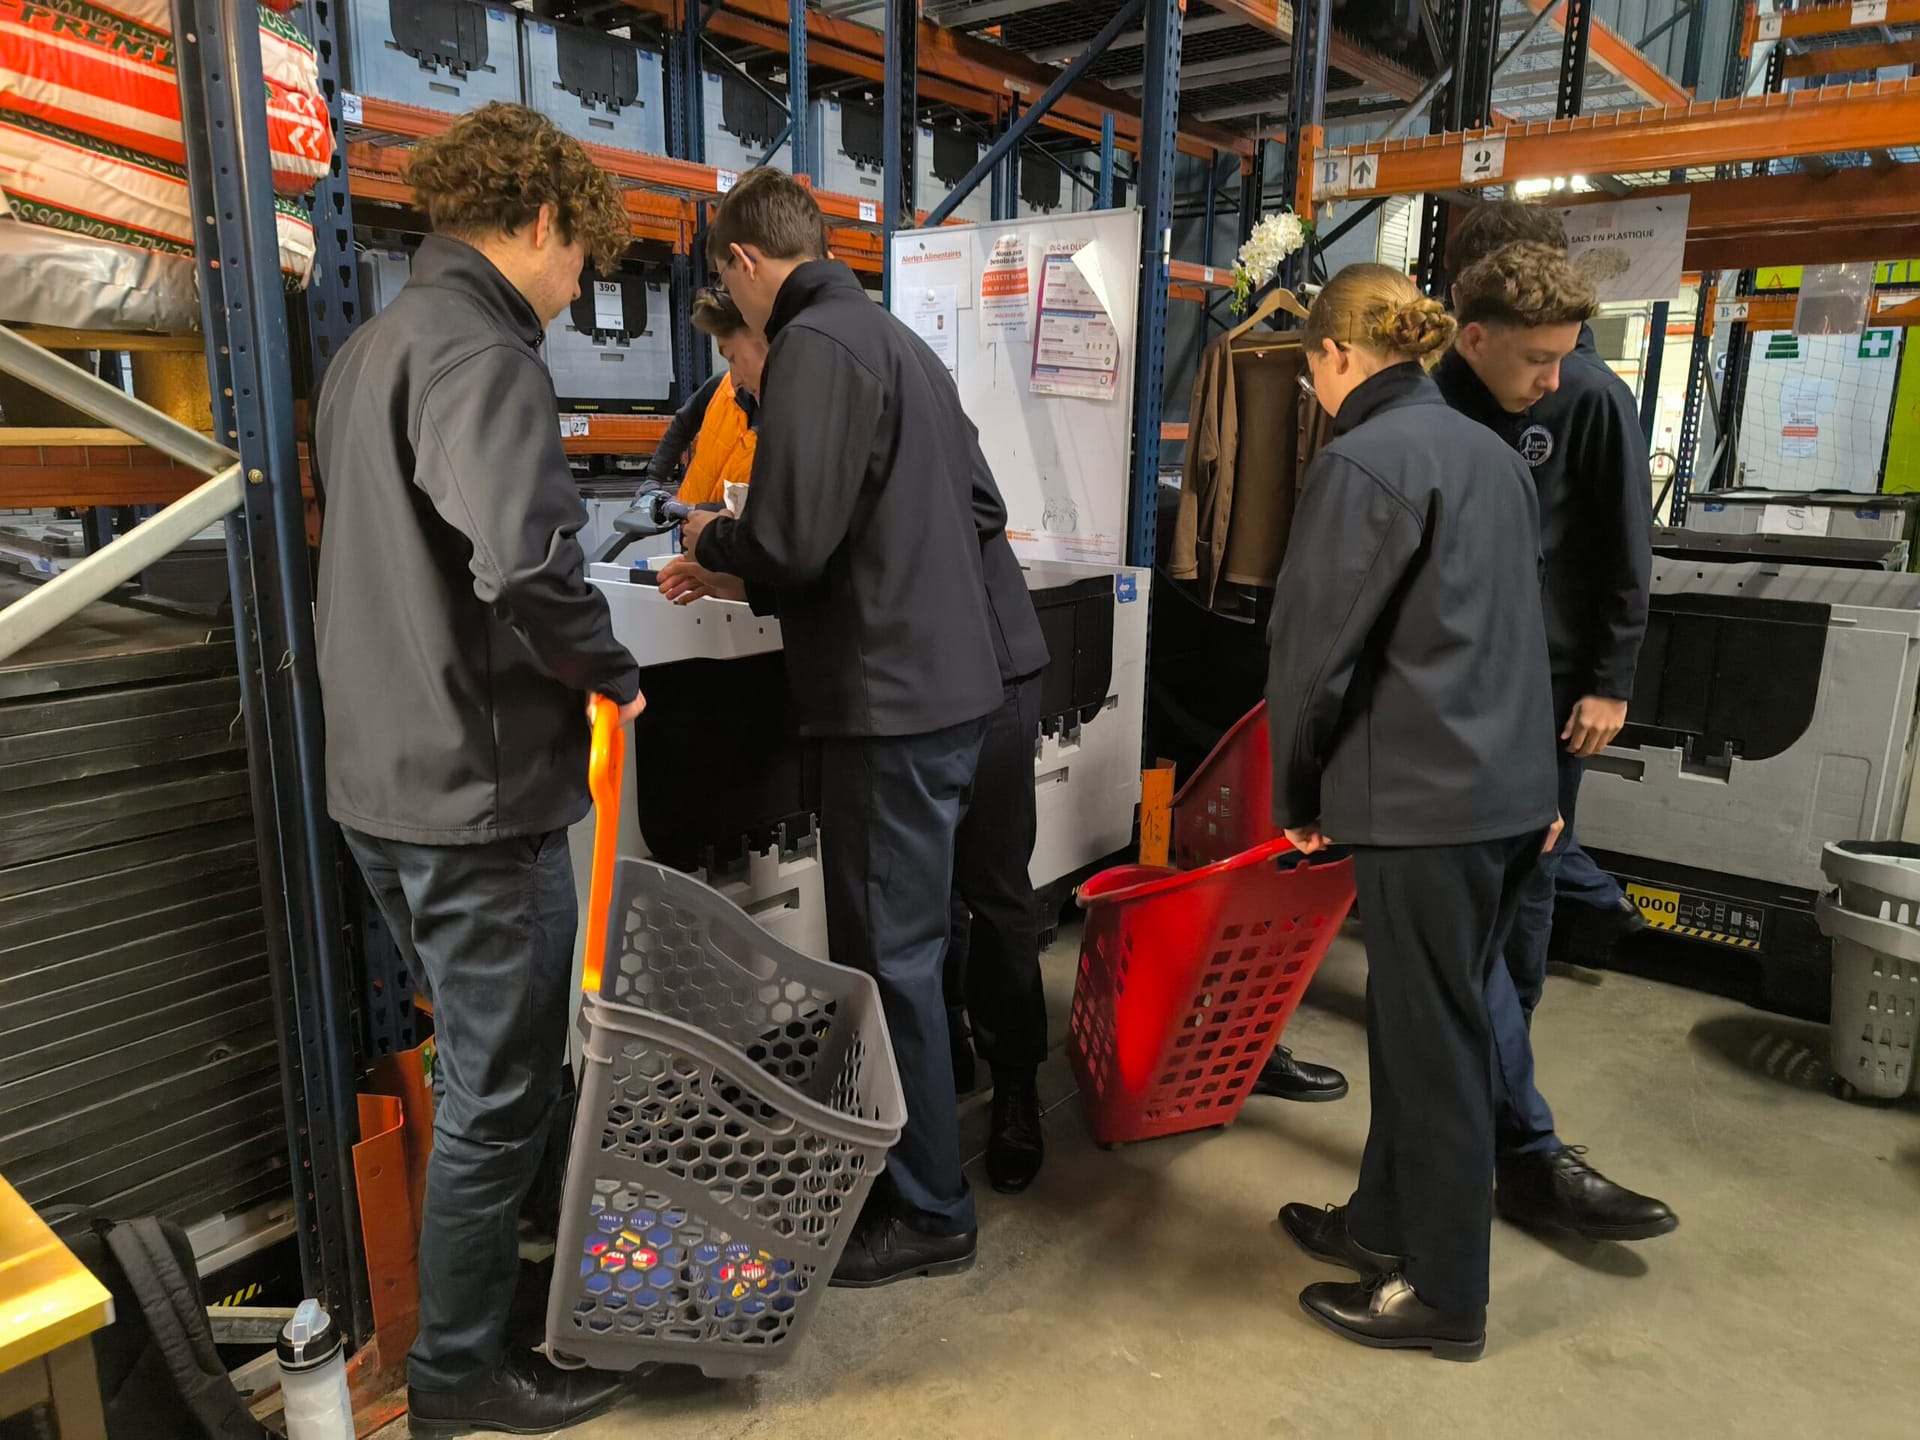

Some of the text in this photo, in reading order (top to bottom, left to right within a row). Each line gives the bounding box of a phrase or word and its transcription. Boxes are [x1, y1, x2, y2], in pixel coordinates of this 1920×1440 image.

[1473, 150, 1492, 173] 2
[1323, 161, 1339, 184] B
[721, 175, 733, 188] 29
[863, 205, 873, 218] 31
[1593, 233, 1605, 241] EN
[1607, 228, 1655, 241] PLASTIQUE
[902, 250, 962, 263] Alertes Alimentaires
[599, 283, 617, 293] 390
[1720, 306, 1730, 318] B
[573, 422, 587, 433] 27
